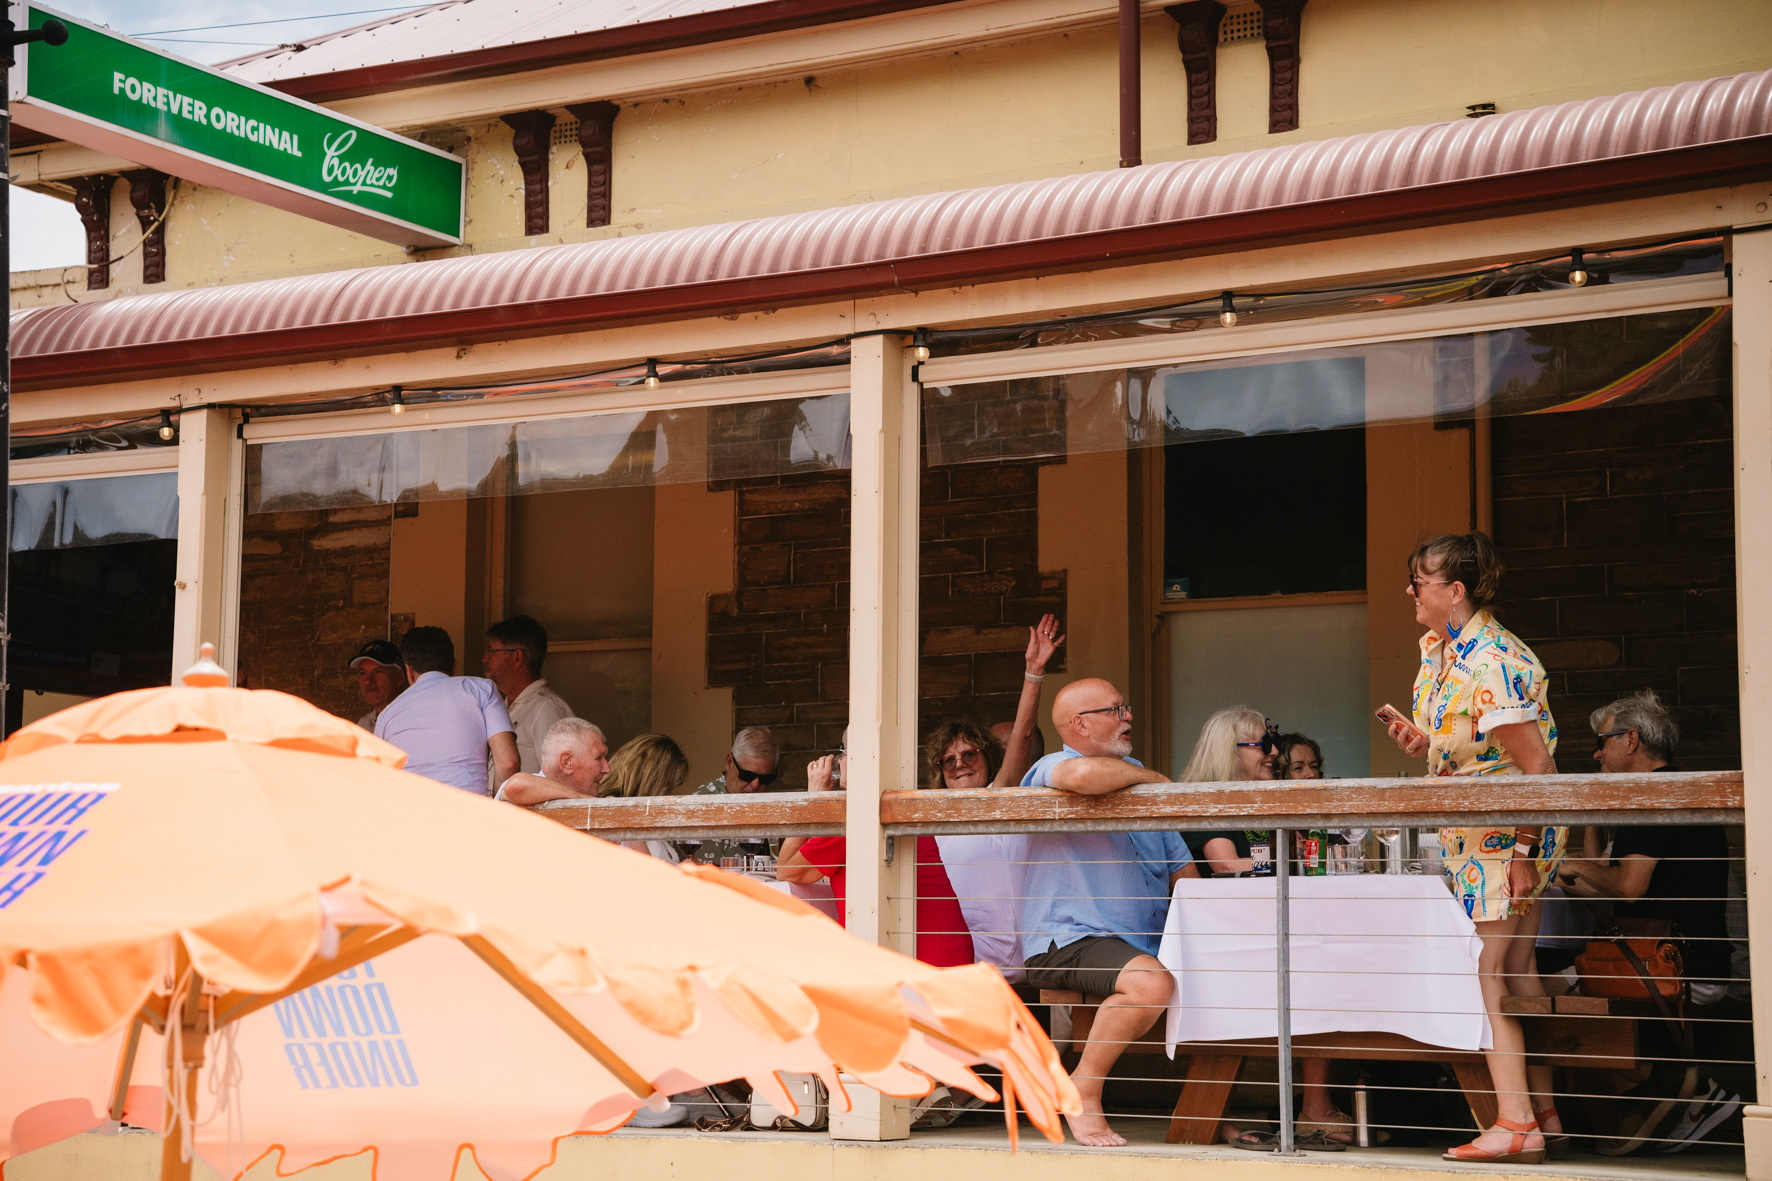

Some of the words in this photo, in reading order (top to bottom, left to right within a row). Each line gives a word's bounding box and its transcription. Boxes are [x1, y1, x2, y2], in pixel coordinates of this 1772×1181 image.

[113, 71, 208, 125] FOREVER
[210, 106, 302, 157] ORIGINAL
[322, 130, 399, 196] Coopers
